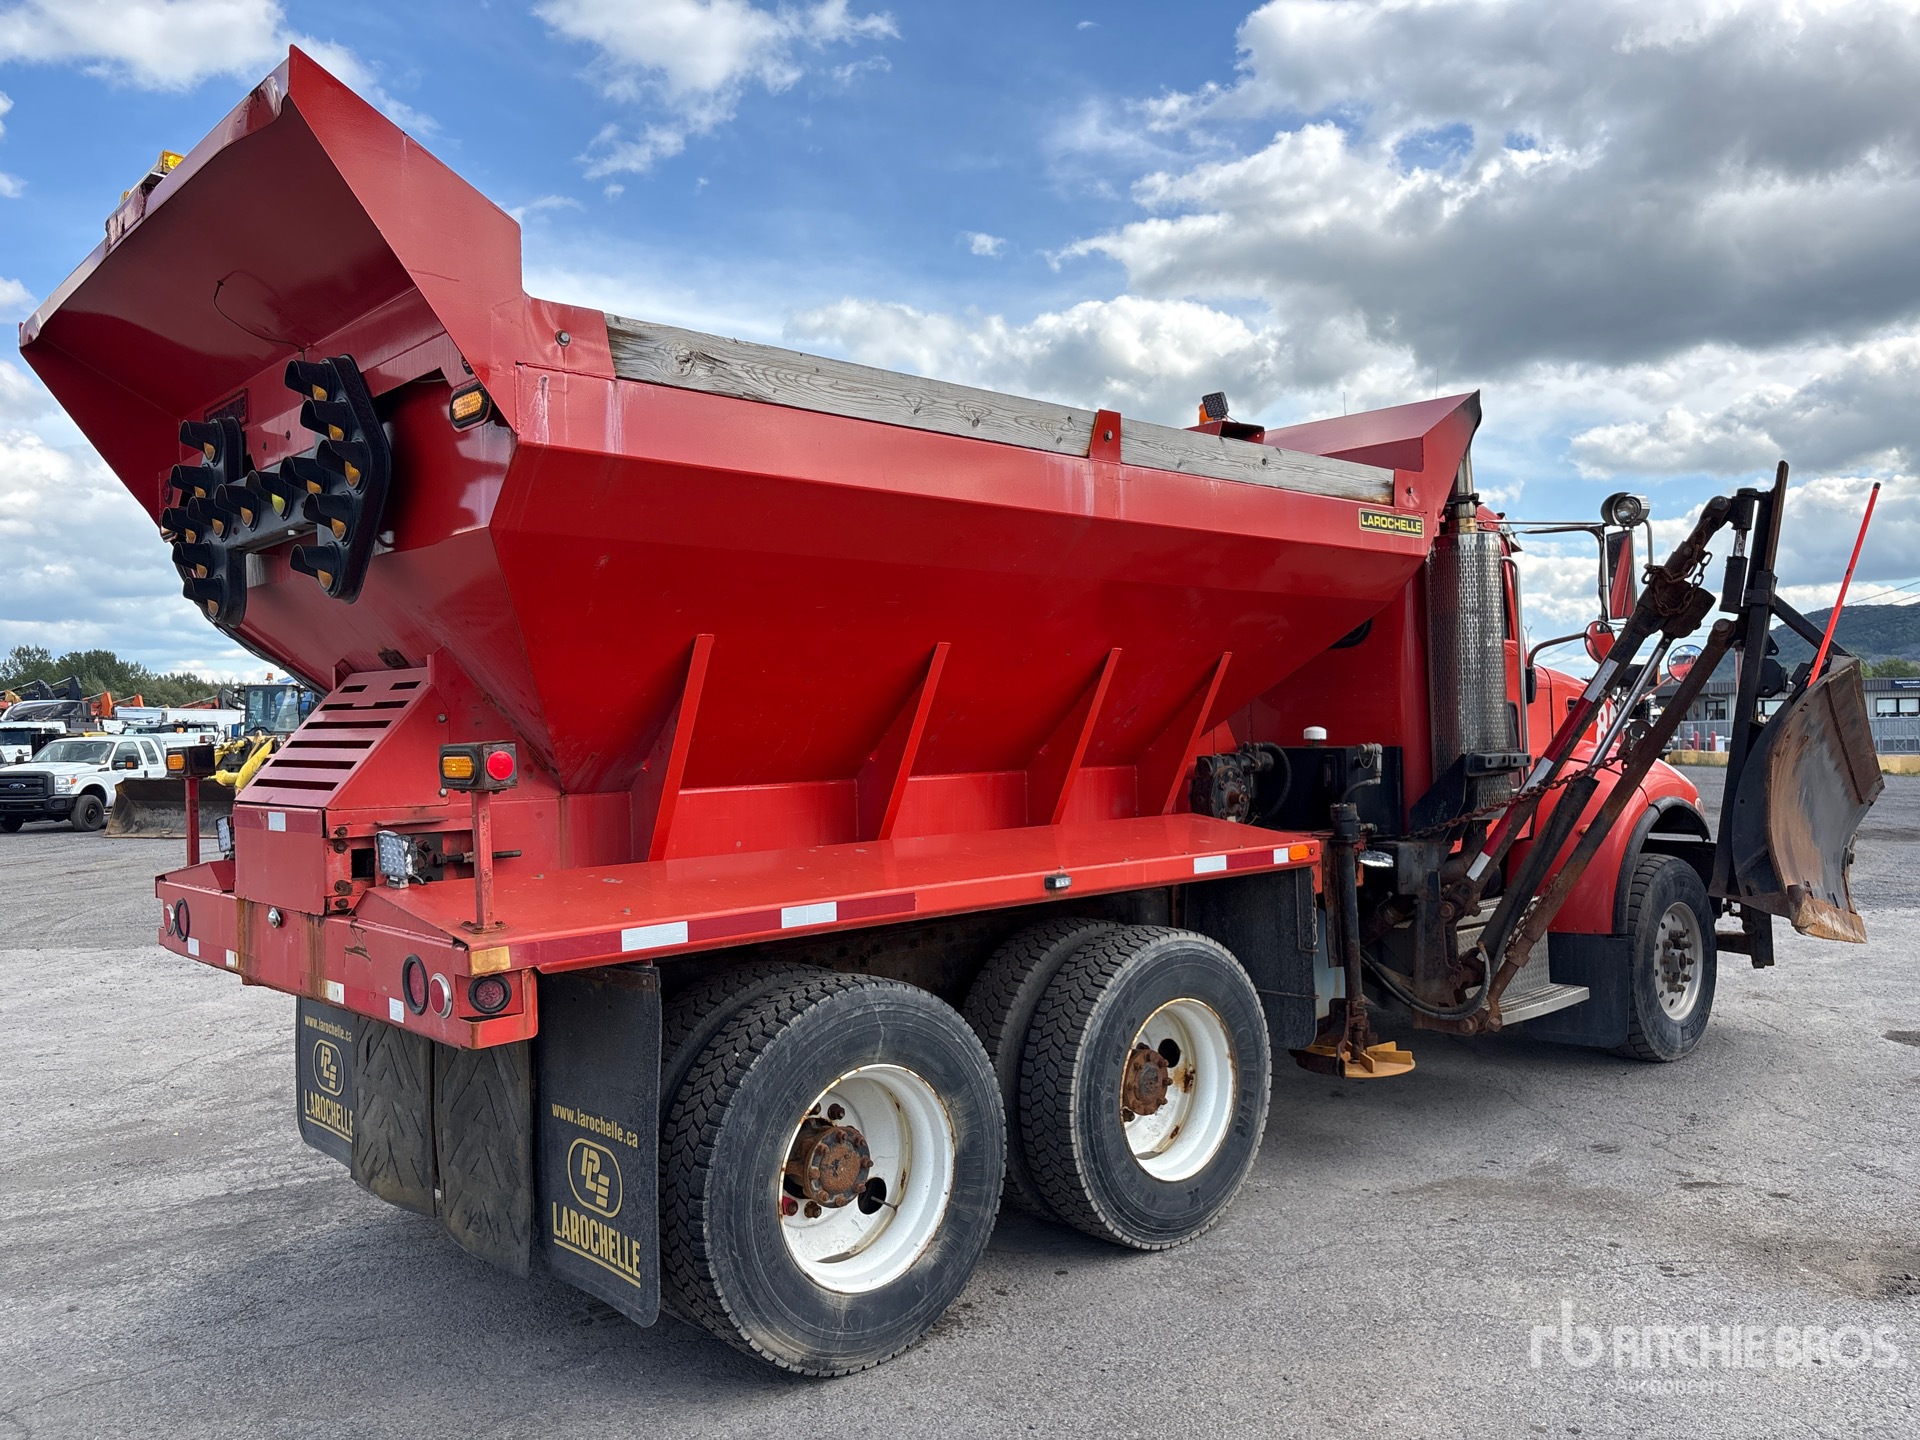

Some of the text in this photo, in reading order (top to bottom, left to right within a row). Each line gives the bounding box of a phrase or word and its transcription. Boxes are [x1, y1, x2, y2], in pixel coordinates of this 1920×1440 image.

[1361, 513, 1422, 533] LAROCHELLE
[304, 1014, 352, 1042] www.larochelle.ca
[552, 1103, 639, 1149] www.larochelle.ca
[552, 1201, 641, 1279] LAROCHELLE
